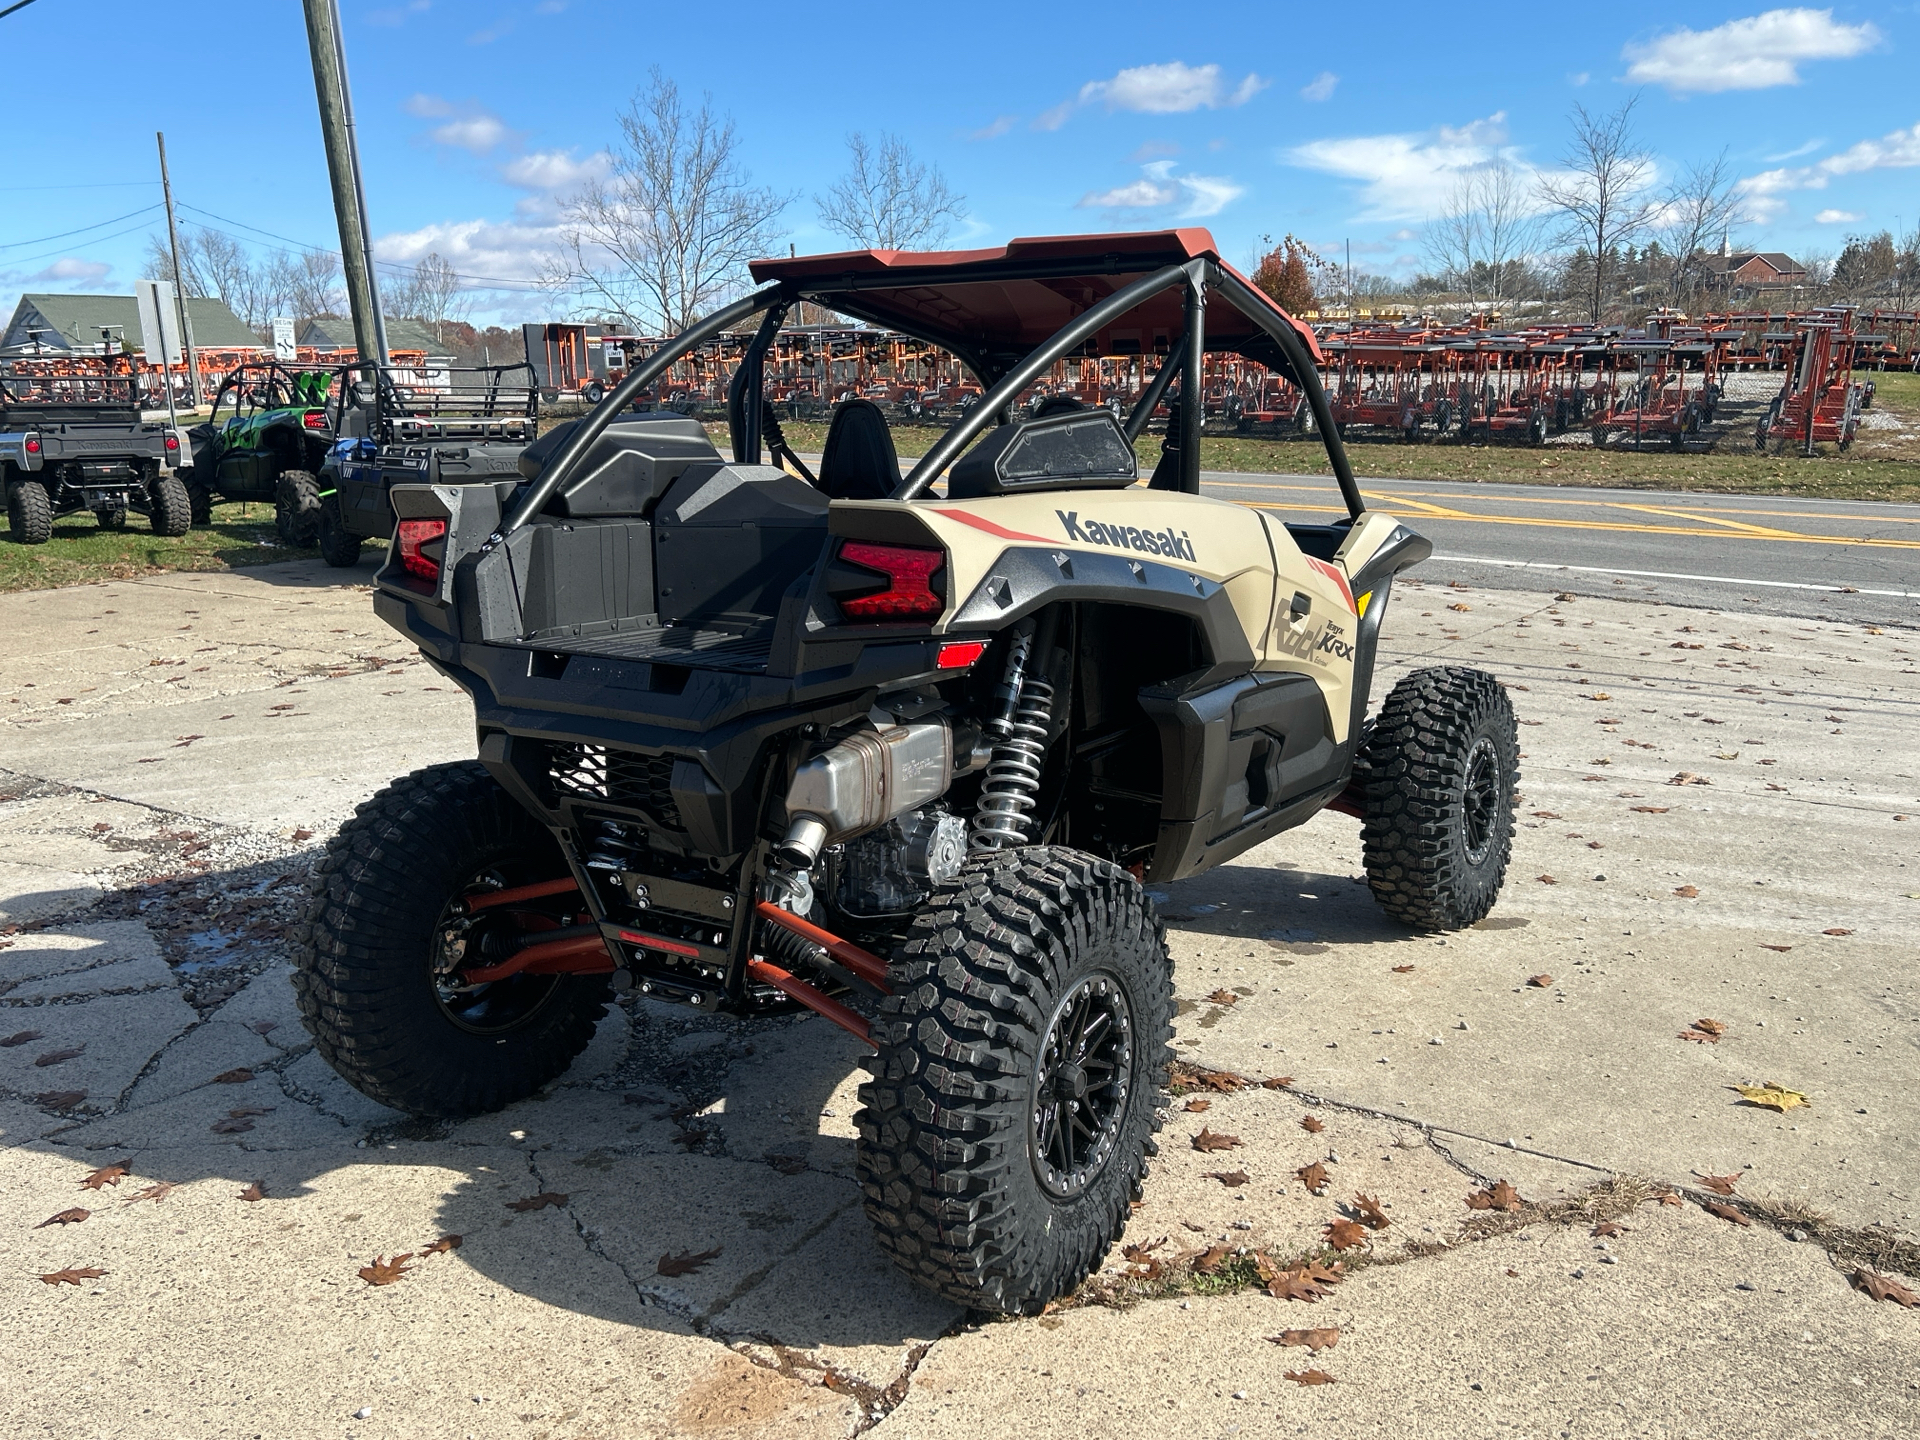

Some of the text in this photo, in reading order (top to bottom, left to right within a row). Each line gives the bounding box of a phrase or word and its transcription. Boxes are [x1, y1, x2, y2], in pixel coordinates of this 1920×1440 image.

[77, 440, 132, 450] Kawasaki
[1055, 509, 1197, 563] Kawasaki
[1003, 628, 1033, 684] FOX
[1317, 631, 1355, 663] KRX
